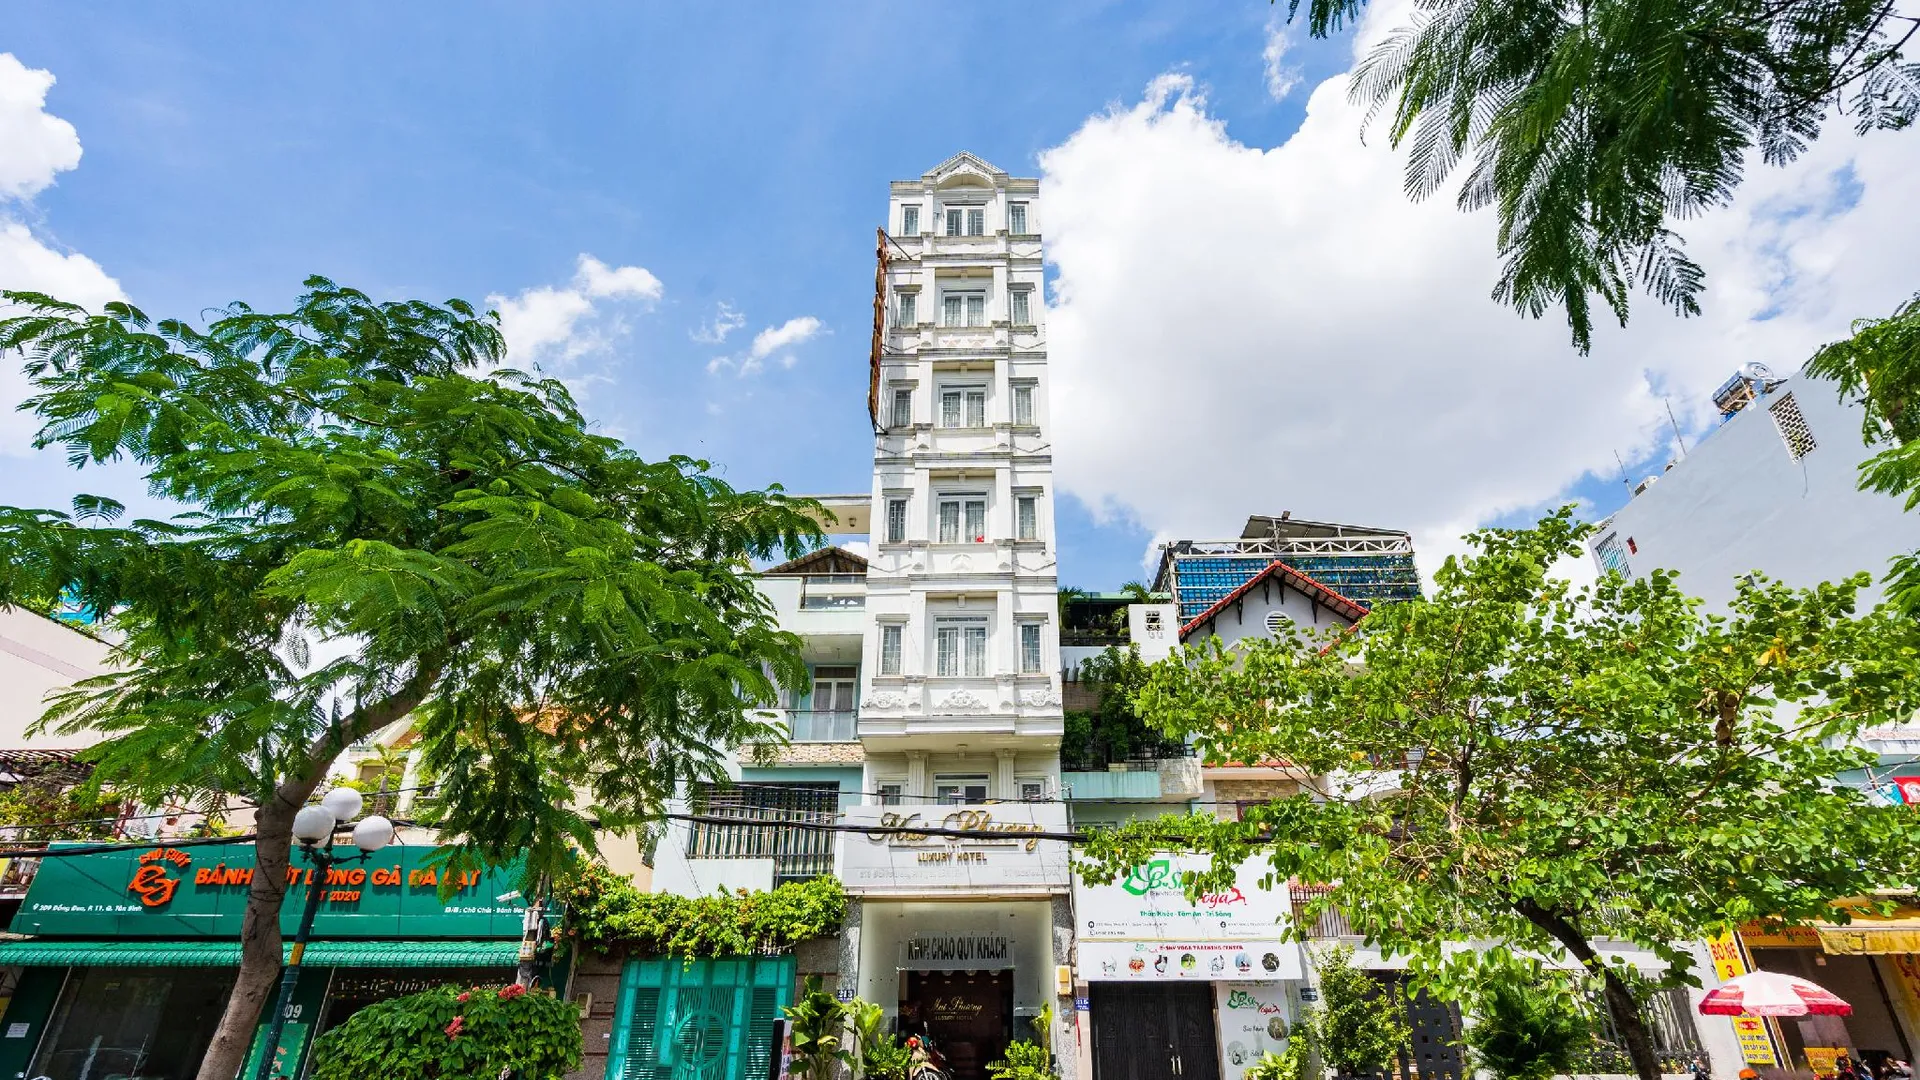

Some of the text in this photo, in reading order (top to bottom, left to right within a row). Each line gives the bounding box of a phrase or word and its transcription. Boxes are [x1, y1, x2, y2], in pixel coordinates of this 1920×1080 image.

[917, 852, 988, 863] LUXURY HOTEL
[195, 863, 254, 885] BÁNH
[371, 865, 402, 886] GÀ
[328, 890, 361, 902] 2020
[932, 931, 955, 960] CHÀO
[957, 931, 975, 961] QUÝ
[977, 931, 1007, 960] KHÁCH
[1726, 964, 1736, 978] 3
[838, 990, 853, 998] 213
[284, 1004, 303, 1019] 09
